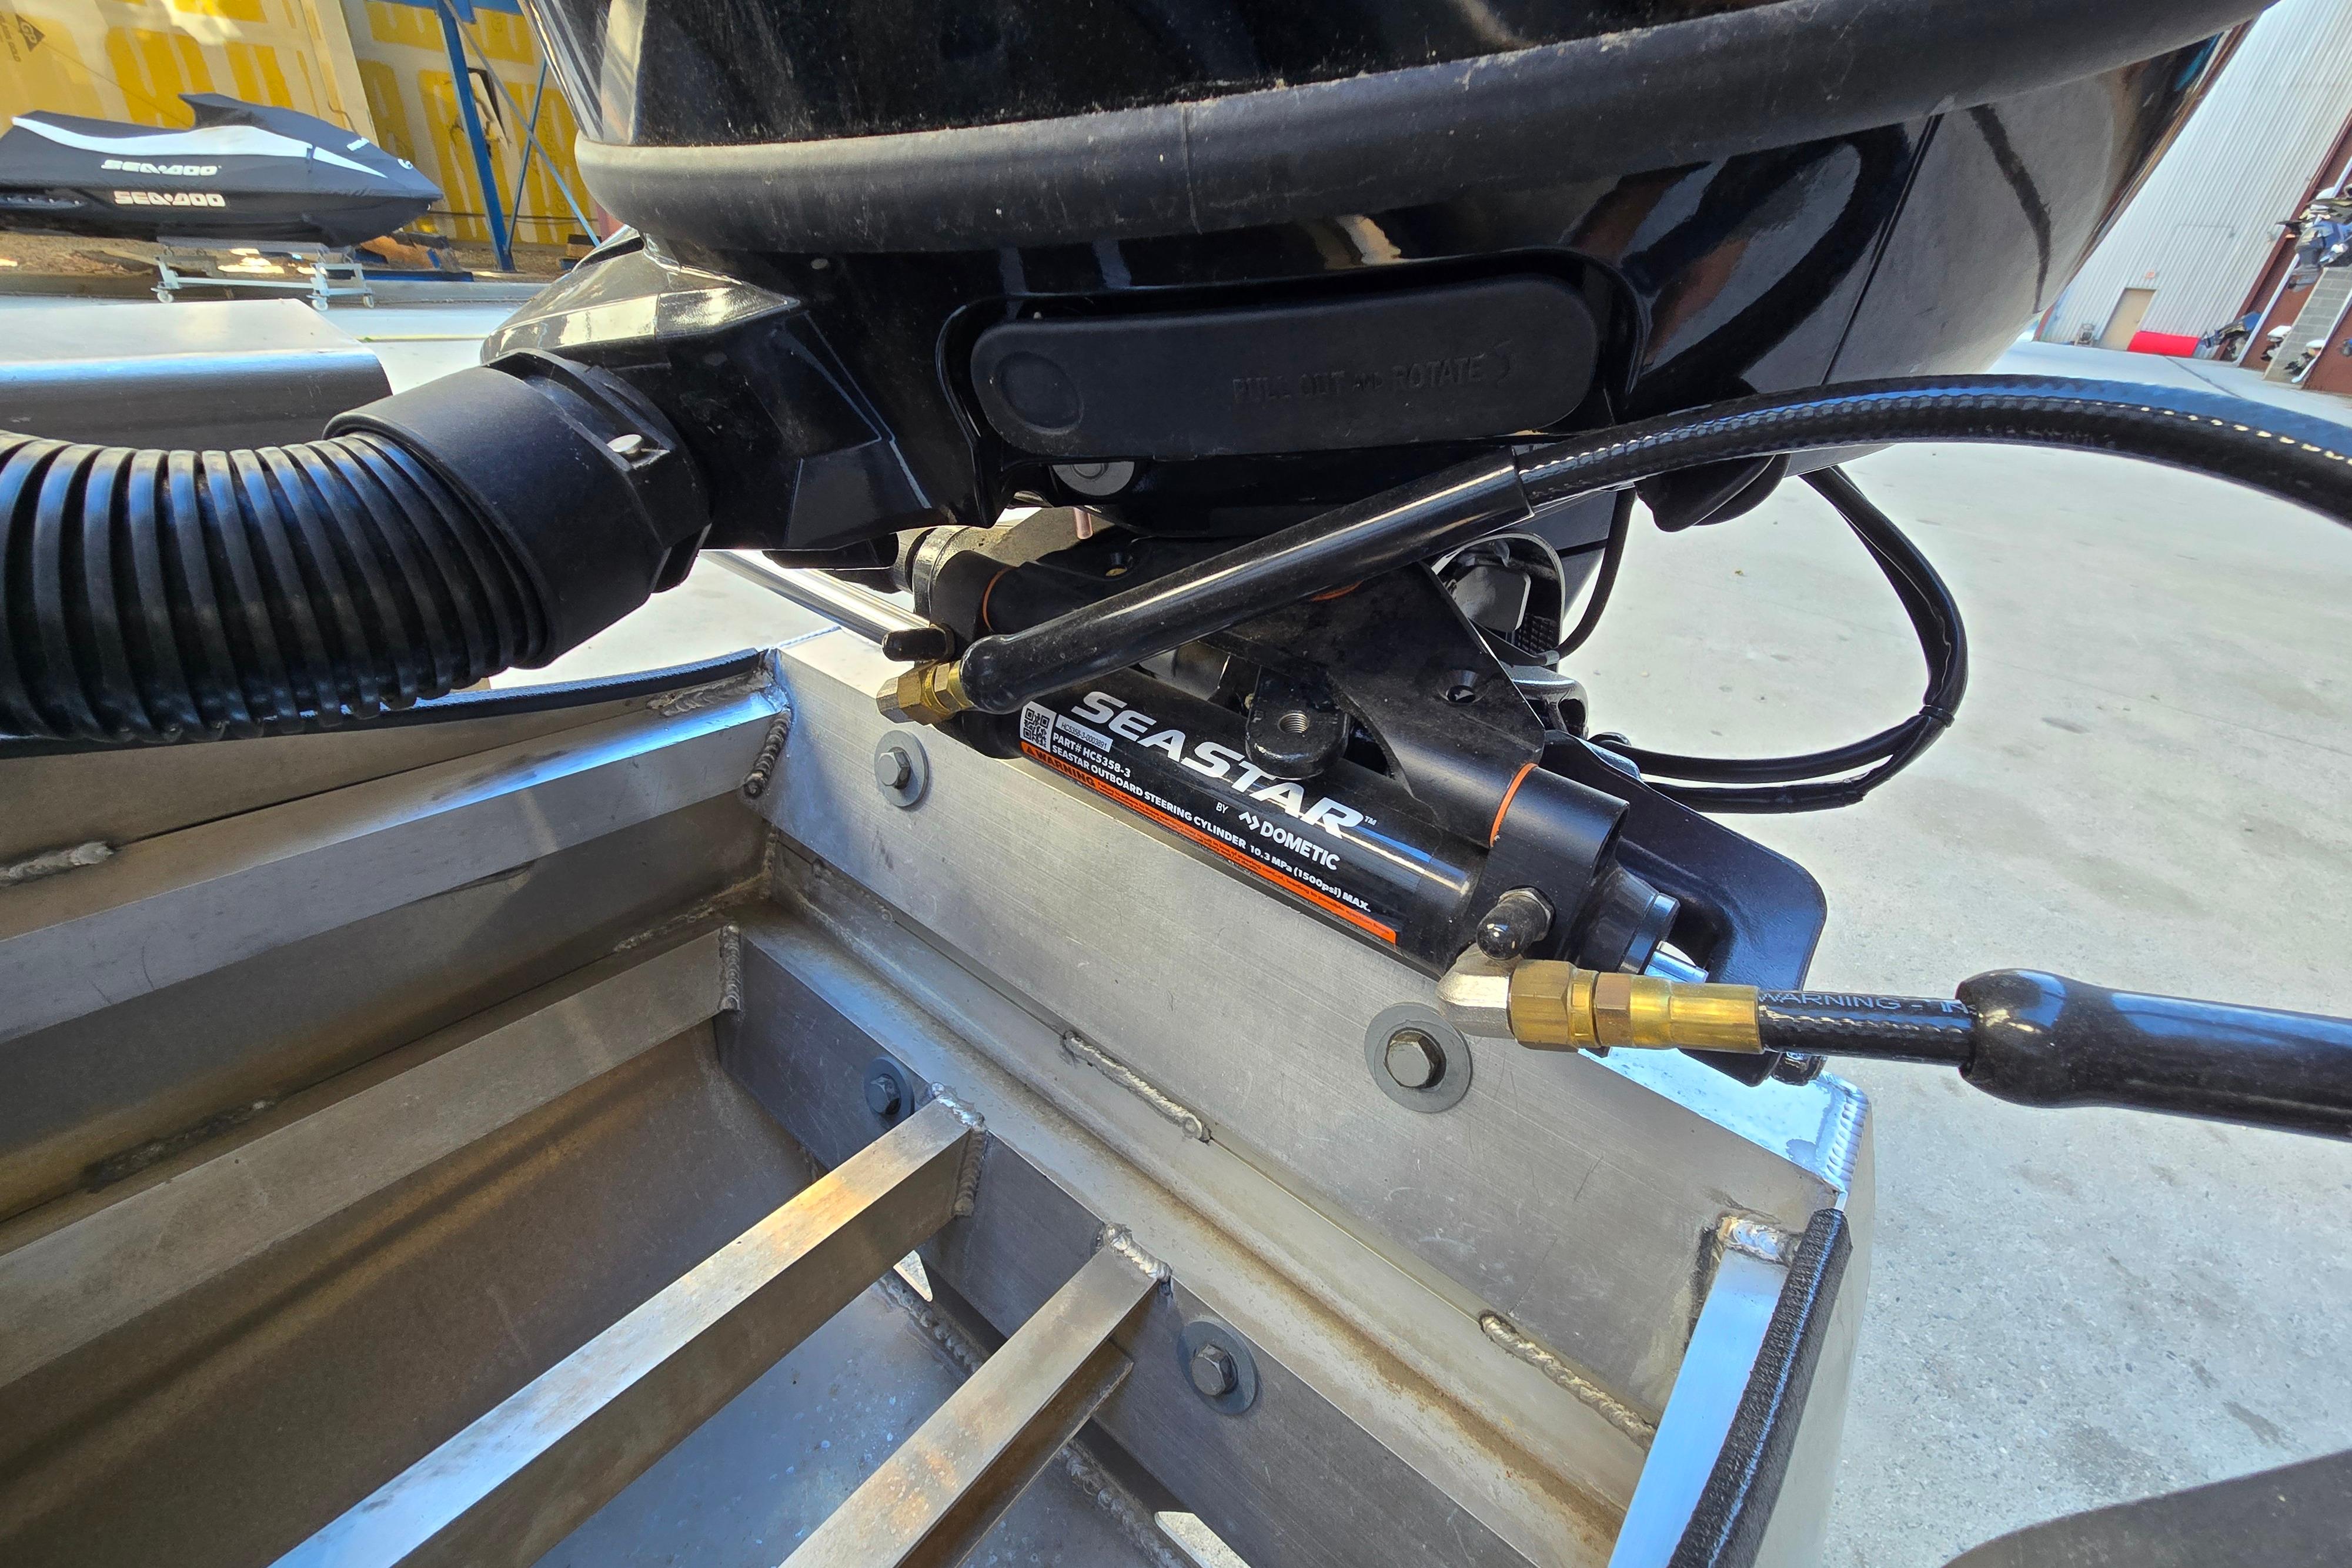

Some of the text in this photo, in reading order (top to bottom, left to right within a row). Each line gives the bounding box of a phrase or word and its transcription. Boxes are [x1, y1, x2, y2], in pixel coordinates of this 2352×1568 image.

[1391, 352, 1486, 390] ROTATE
[1060, 721, 1107, 750] HC5358-3-0003891
[1034, 749, 1096, 787] WARNING
[1053, 732, 1131, 778] PART# HC5358-3
[1071, 691, 1365, 840] SEASTAR
[1215, 801, 1229, 814] BY
[1052, 745, 1372, 912] SEASTAR OUTBOARD STEERING CYLINDER 10.3 MPa (1500psi) MAX.
[1260, 821, 1341, 871] DOMETIC
[1758, 992, 1902, 1009] WARNING
